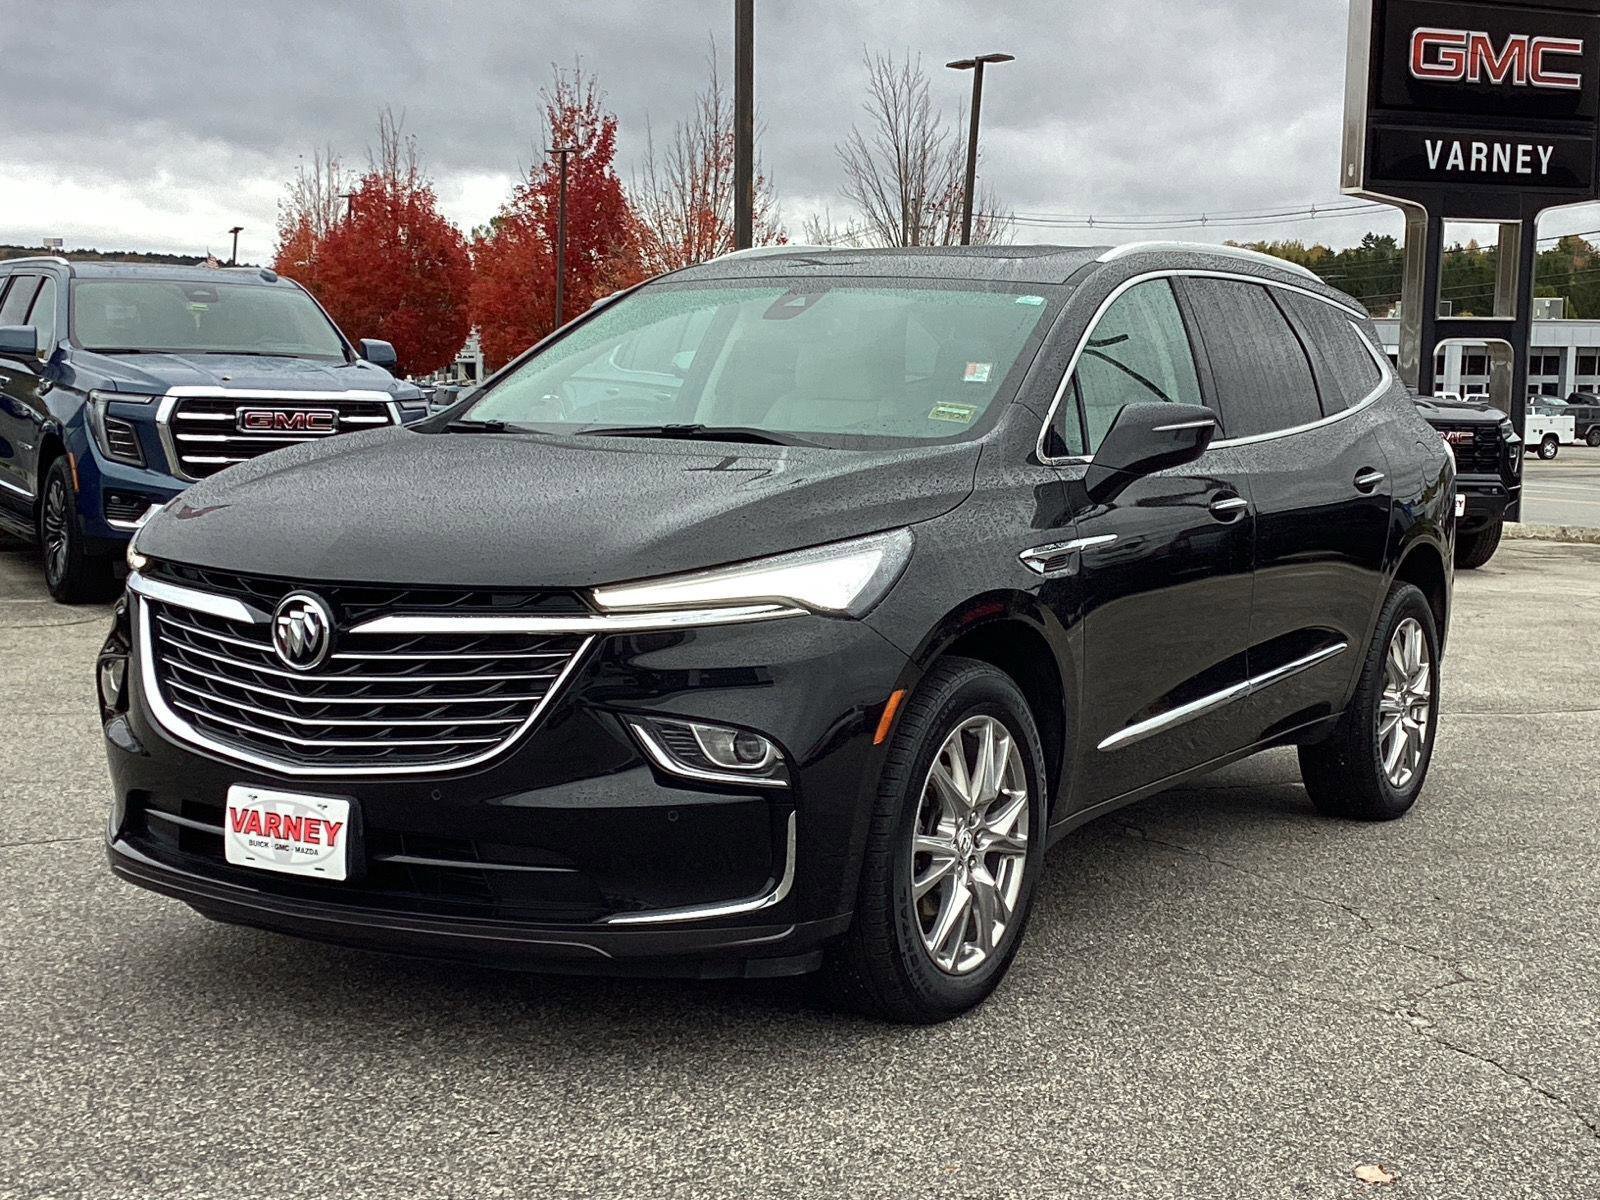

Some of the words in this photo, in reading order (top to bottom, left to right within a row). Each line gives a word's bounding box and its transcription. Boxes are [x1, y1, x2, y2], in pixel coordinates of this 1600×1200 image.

[1410, 27, 1583, 90] GMC
[1425, 139, 1554, 175] VARNEY
[244, 411, 333, 430] GMC
[1437, 431, 1474, 445] MC
[229, 806, 343, 847] VARNEY
[248, 839, 269, 848] BUICK
[274, 843, 290, 852] GMC
[294, 846, 319, 856] MAZDA
